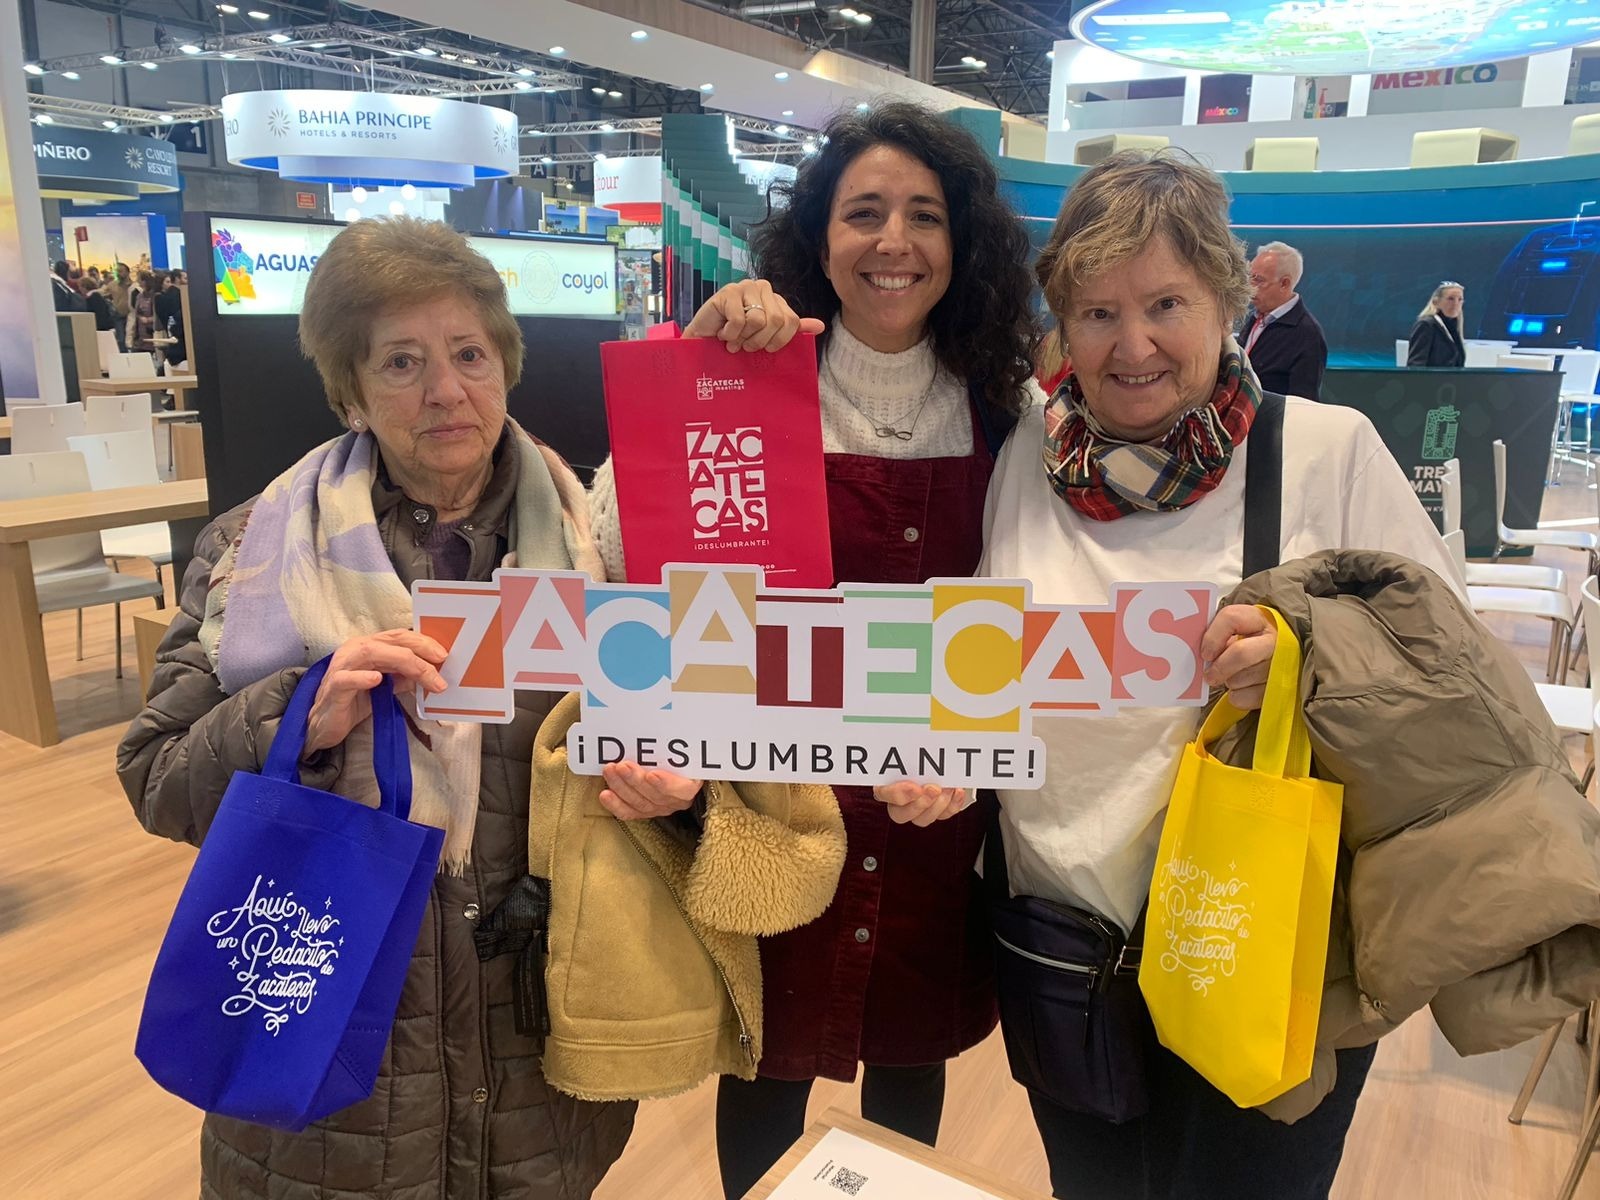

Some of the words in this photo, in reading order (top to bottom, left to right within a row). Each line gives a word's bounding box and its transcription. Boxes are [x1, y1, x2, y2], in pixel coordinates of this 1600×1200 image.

[299, 109, 350, 125] BAHIA
[356, 111, 432, 130] PRINCIPE
[300, 129, 337, 137] HOTELS
[351, 131, 397, 140] RESORTS
[562, 271, 608, 294] coyol
[697, 379, 744, 387] ZACATECAS
[417, 570, 1211, 732] ZACATECAS
[206, 874, 298, 937] Aquí
[216, 936, 239, 949] un
[242, 923, 339, 973] Pedacito
[320, 960, 335, 976] de
